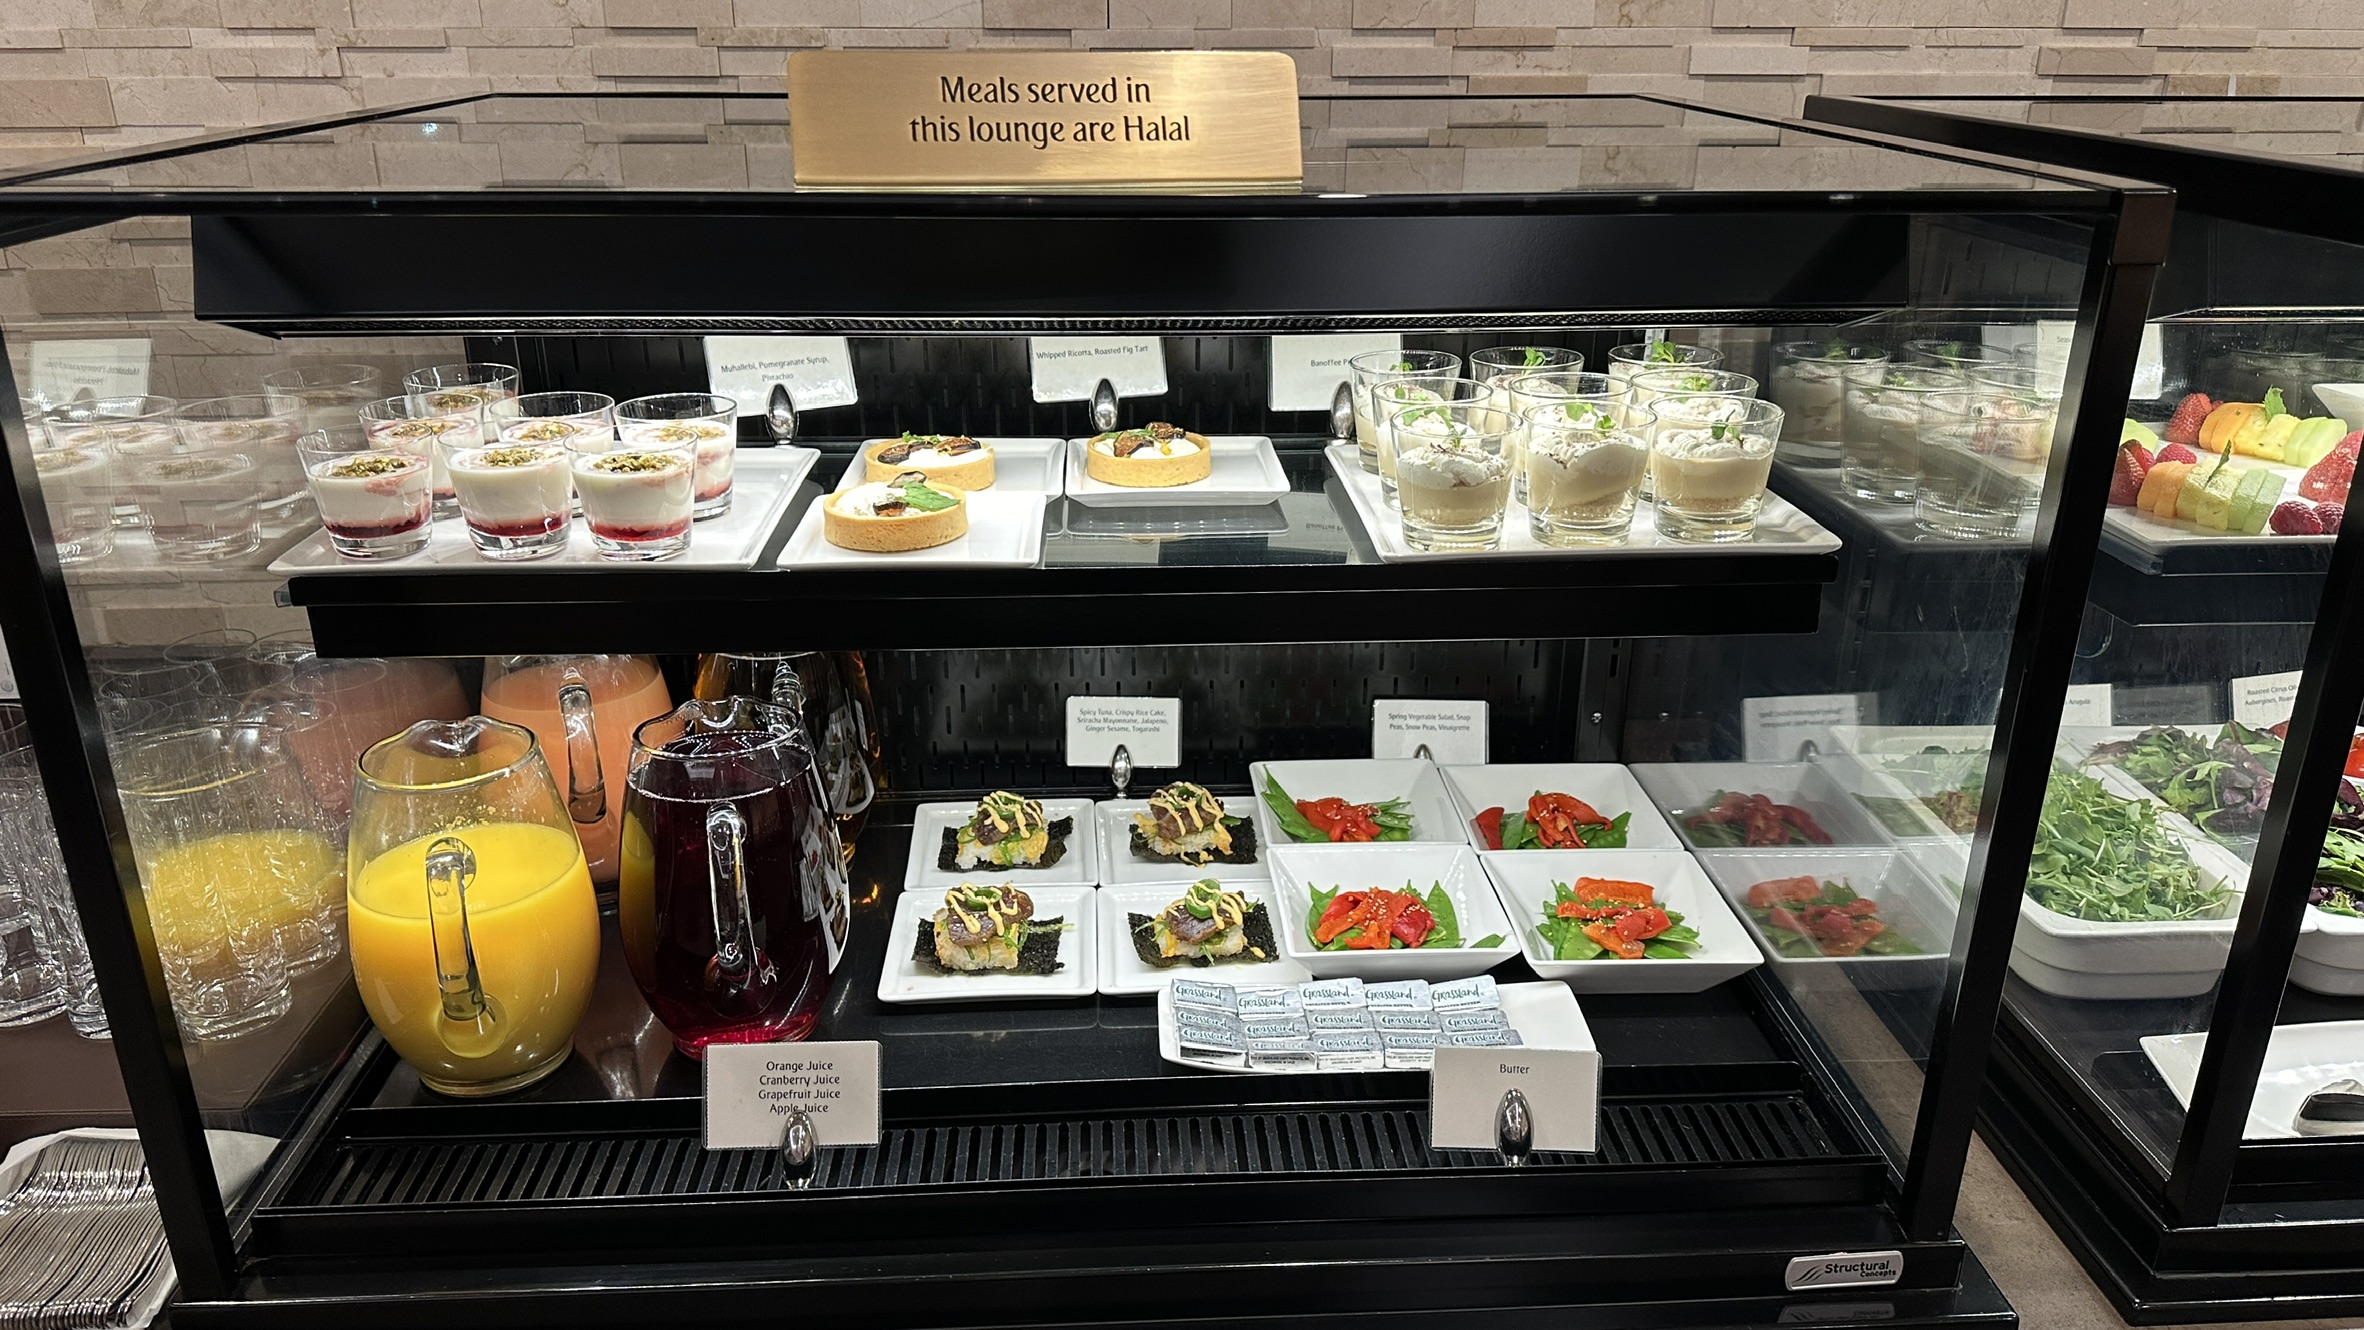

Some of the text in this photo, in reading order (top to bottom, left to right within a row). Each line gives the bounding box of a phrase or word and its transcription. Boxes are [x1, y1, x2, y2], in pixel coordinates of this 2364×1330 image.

[940, 76, 1151, 103] Meals served in
[909, 114, 1190, 150] this lounge are Halal
[1036, 350, 1067, 360] Whipped
[1094, 346, 1121, 356] Roasted
[1122, 345, 1134, 355] Fig
[1135, 345, 1149, 353] Tart
[759, 357, 805, 370] Pomegranate
[1310, 359, 1342, 367] Banoffee
[762, 372, 794, 382] Pistachio
[1115, 708, 1134, 717] Crispy
[1135, 708, 1149, 716] Rice
[1388, 713, 1407, 721] Spring
[1408, 713, 1437, 721] Vegetable
[1456, 714, 1471, 722] Snap
[1085, 725, 1105, 733] Ginger
[766, 1060, 833, 1073] Orange Juice
[1499, 1063, 1530, 1074] Butter
[759, 1074, 840, 1087] Cranberry Juice
[758, 1088, 841, 1101] Grapefruit Juice
[769, 1102, 829, 1116] Apple Juice
[1824, 1259, 1890, 1274] Structural
[1859, 1268, 1897, 1278] Concepts
